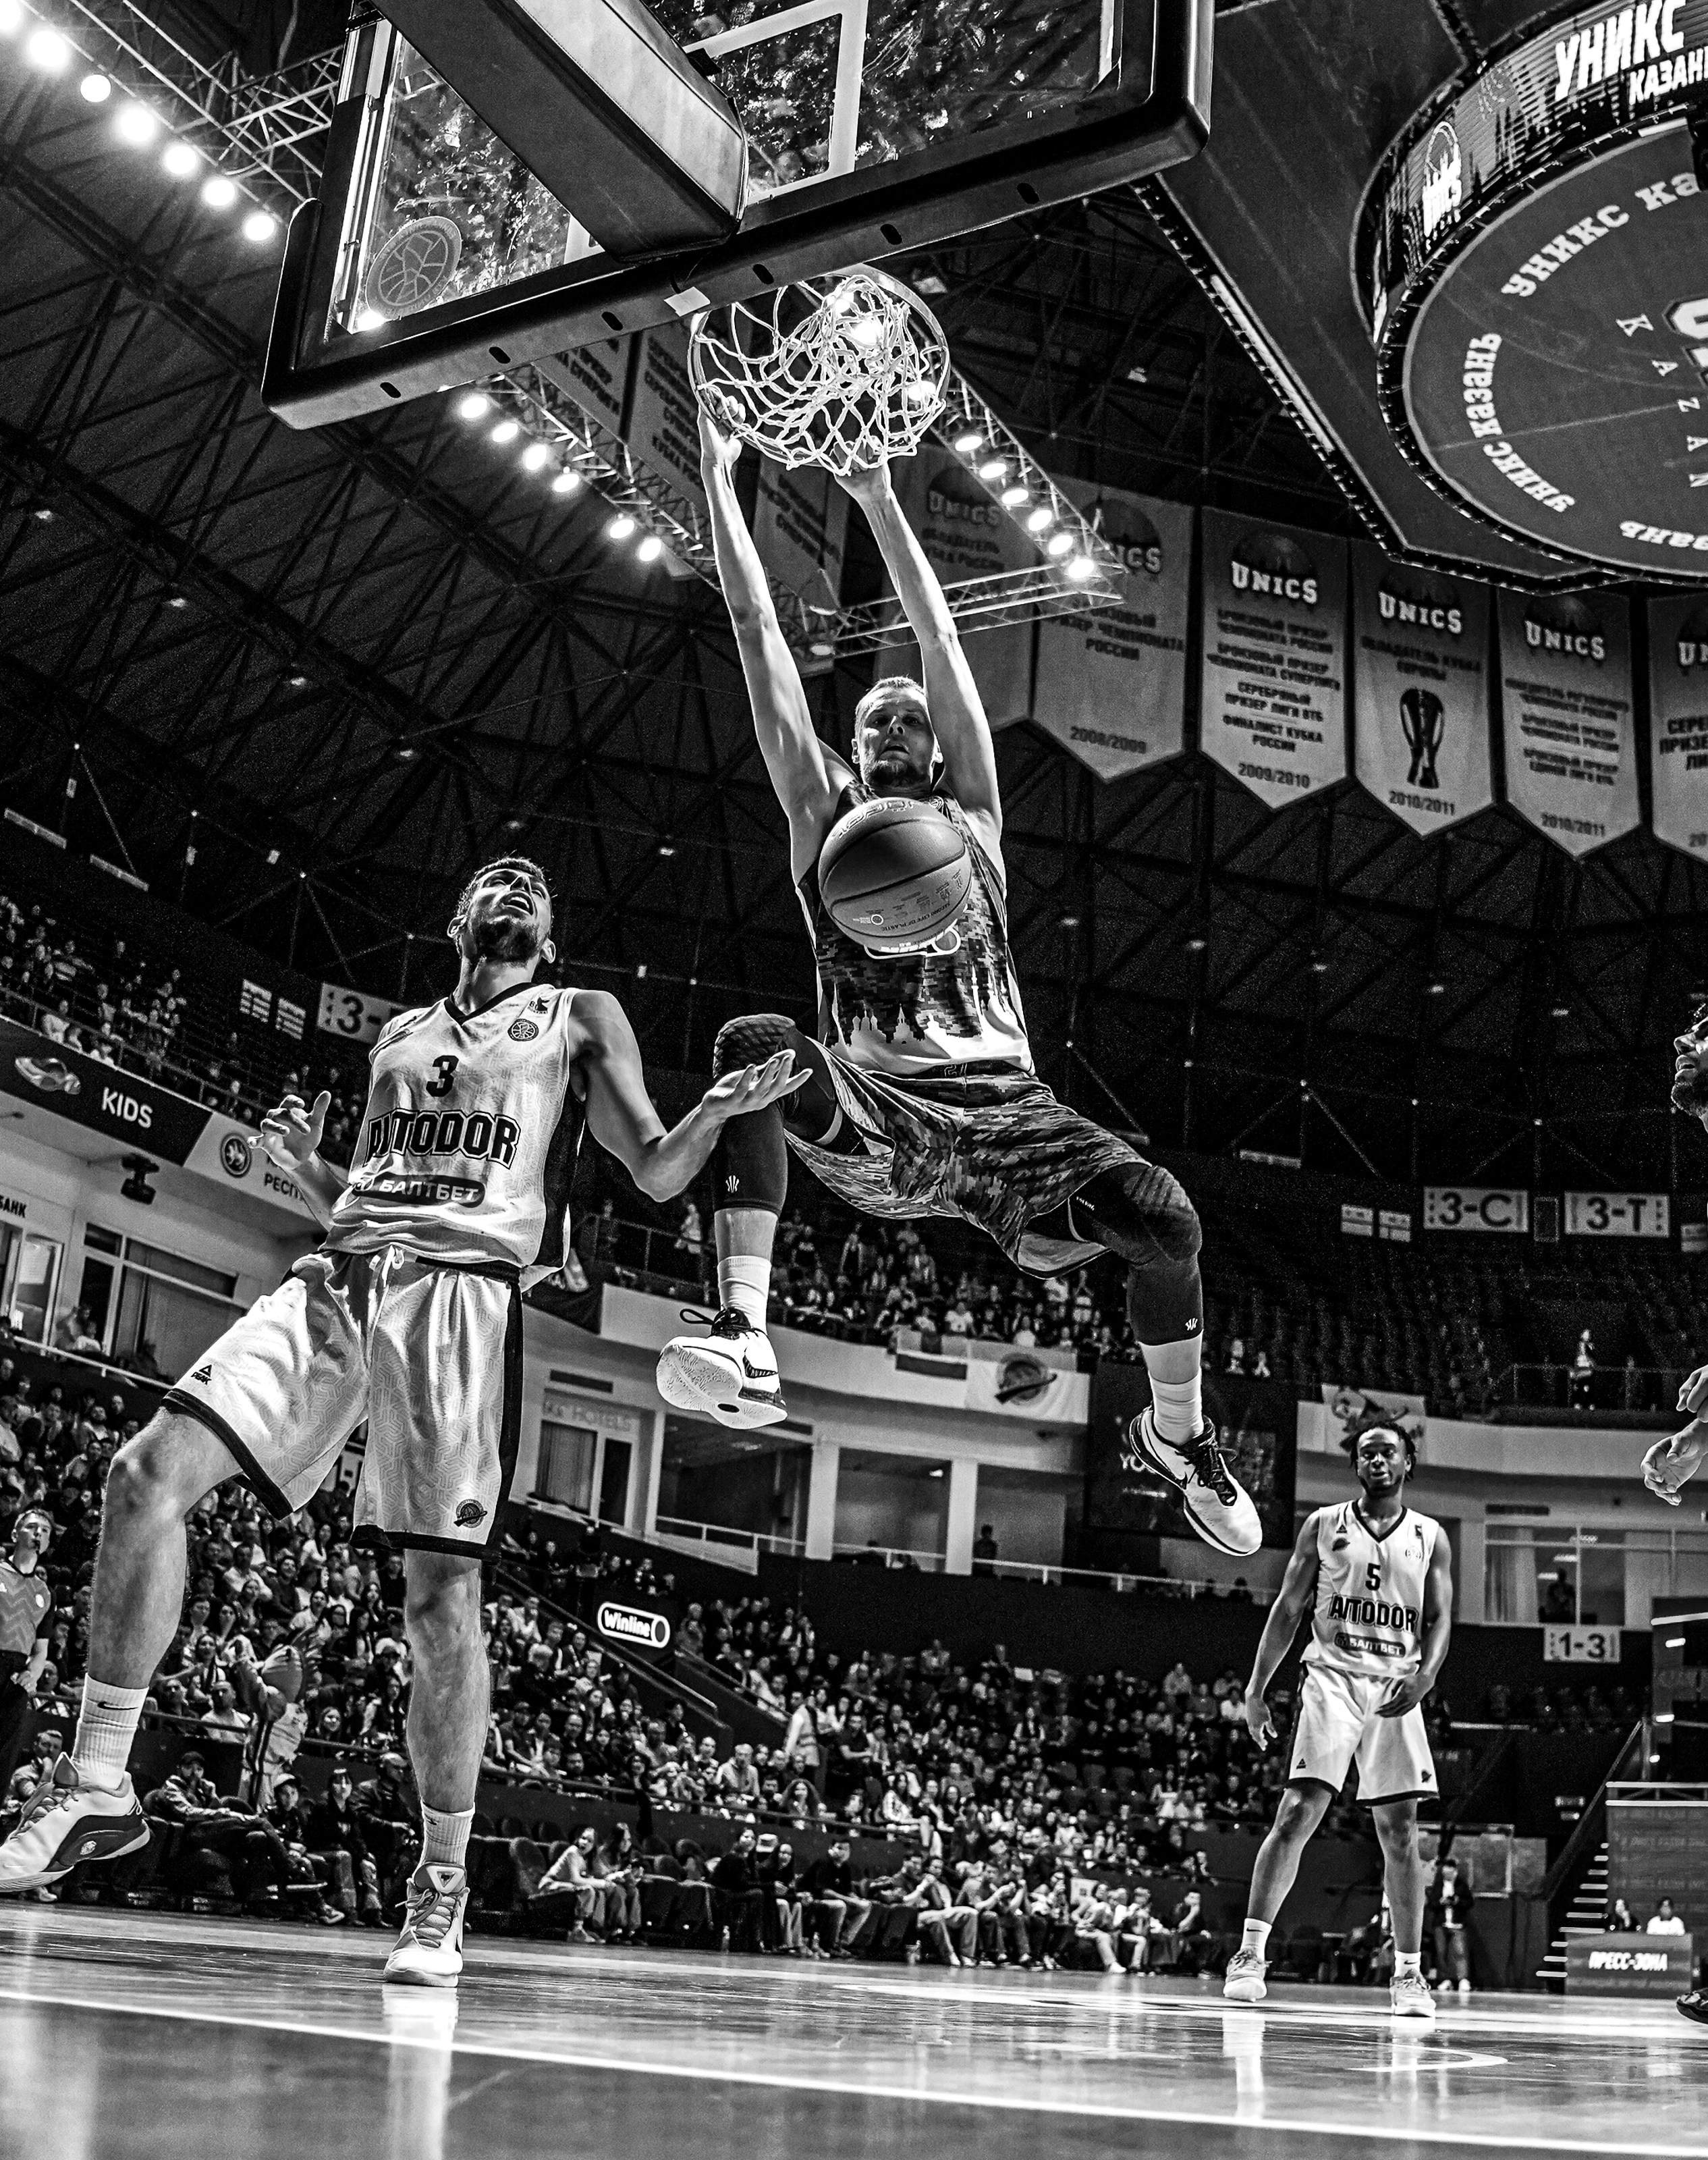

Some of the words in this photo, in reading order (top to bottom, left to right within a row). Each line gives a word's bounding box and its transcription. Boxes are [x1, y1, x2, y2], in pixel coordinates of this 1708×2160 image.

[1555, 0, 1686, 101] УНИКС
[1501, 205, 1630, 297] УНИКС
[1231, 561, 1317, 604] UNICS
[1379, 591, 1462, 634] UNICS
[1524, 620, 1605, 660] UNICS
[1238, 762, 1311, 789] 2009/2010
[426, 1055, 460, 1098] 3
[102, 1087, 153, 1129] KIDS
[264, 1172, 305, 1201] РЕСП
[379, 1179, 479, 1202] БАЛТБЕТ
[1365, 1563, 1381, 1591] 5
[604, 1609, 651, 1638] Winline
[1558, 1631, 1606, 1659] 1-3
[1589, 1951, 1668, 1972] ПРЕСС-ЗОНА
